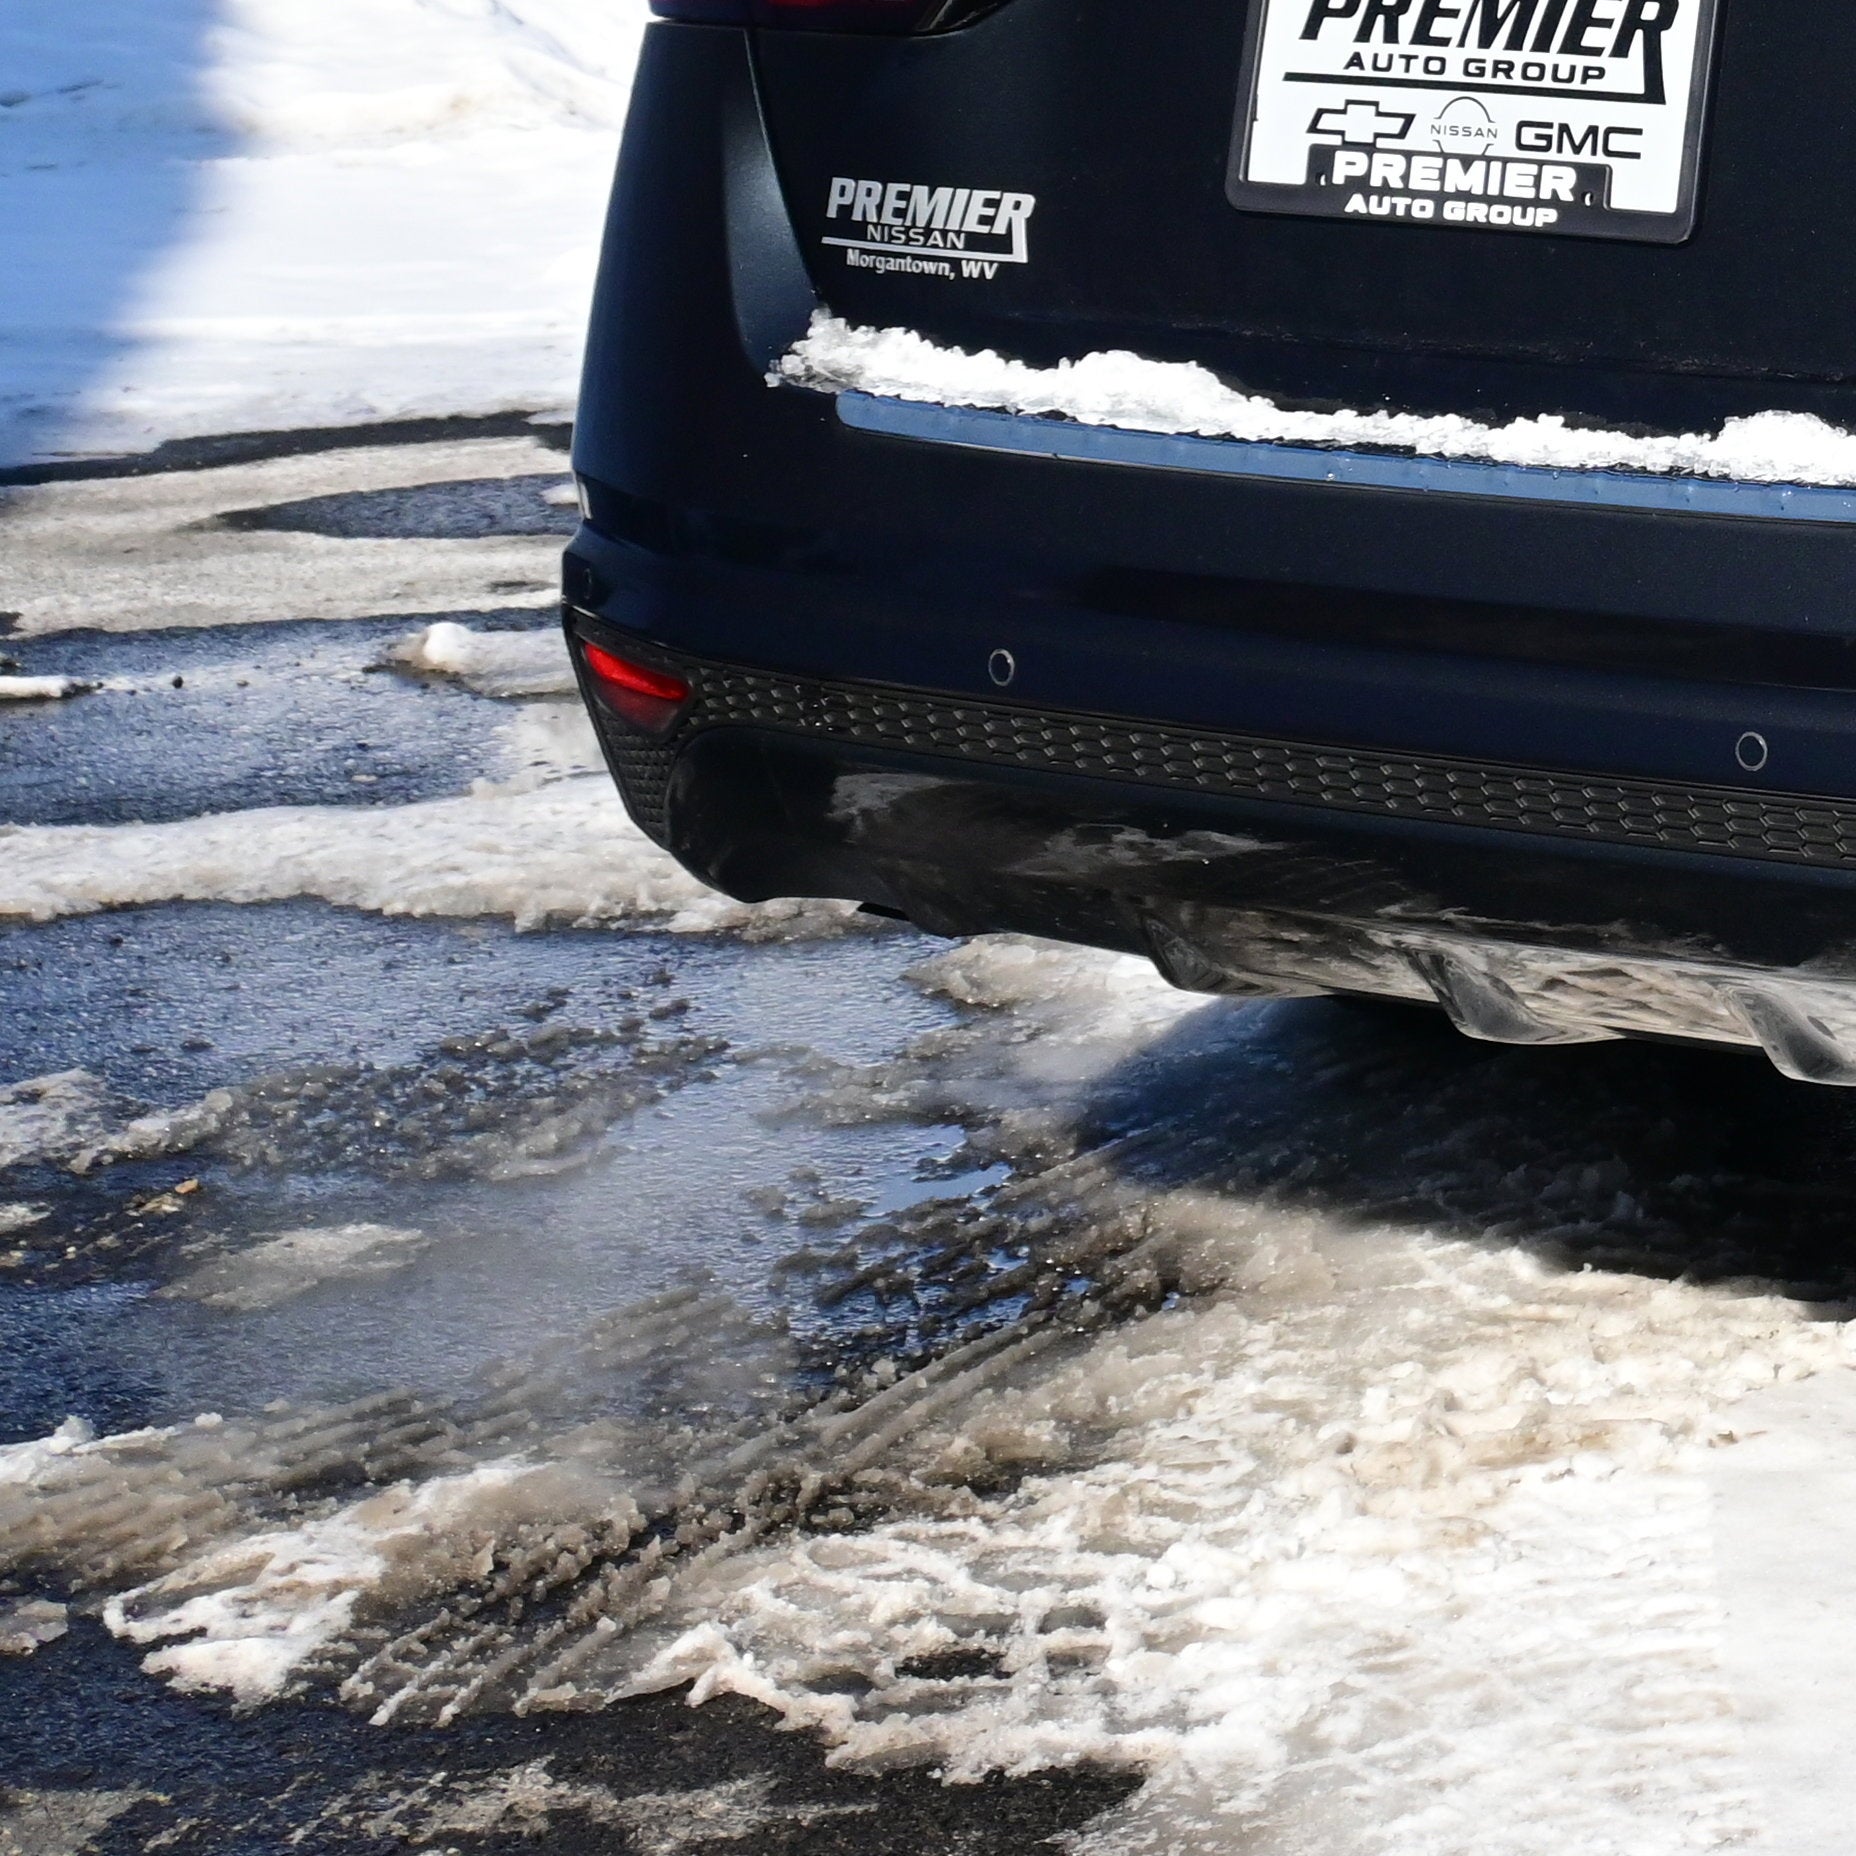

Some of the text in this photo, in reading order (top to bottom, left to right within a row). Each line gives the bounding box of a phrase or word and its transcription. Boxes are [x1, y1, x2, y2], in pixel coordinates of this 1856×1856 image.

[1343, 51, 1606, 85] AUTO GROUP
[1430, 119, 1644, 160] NISSAN GMC
[1331, 150, 1577, 202] PREMIER
[826, 177, 1036, 234] PREMIER
[1344, 193, 1559, 228] AUTO GROUP
[866, 224, 966, 250] NISSAN
[846, 248, 999, 280] Morgantown, WV
